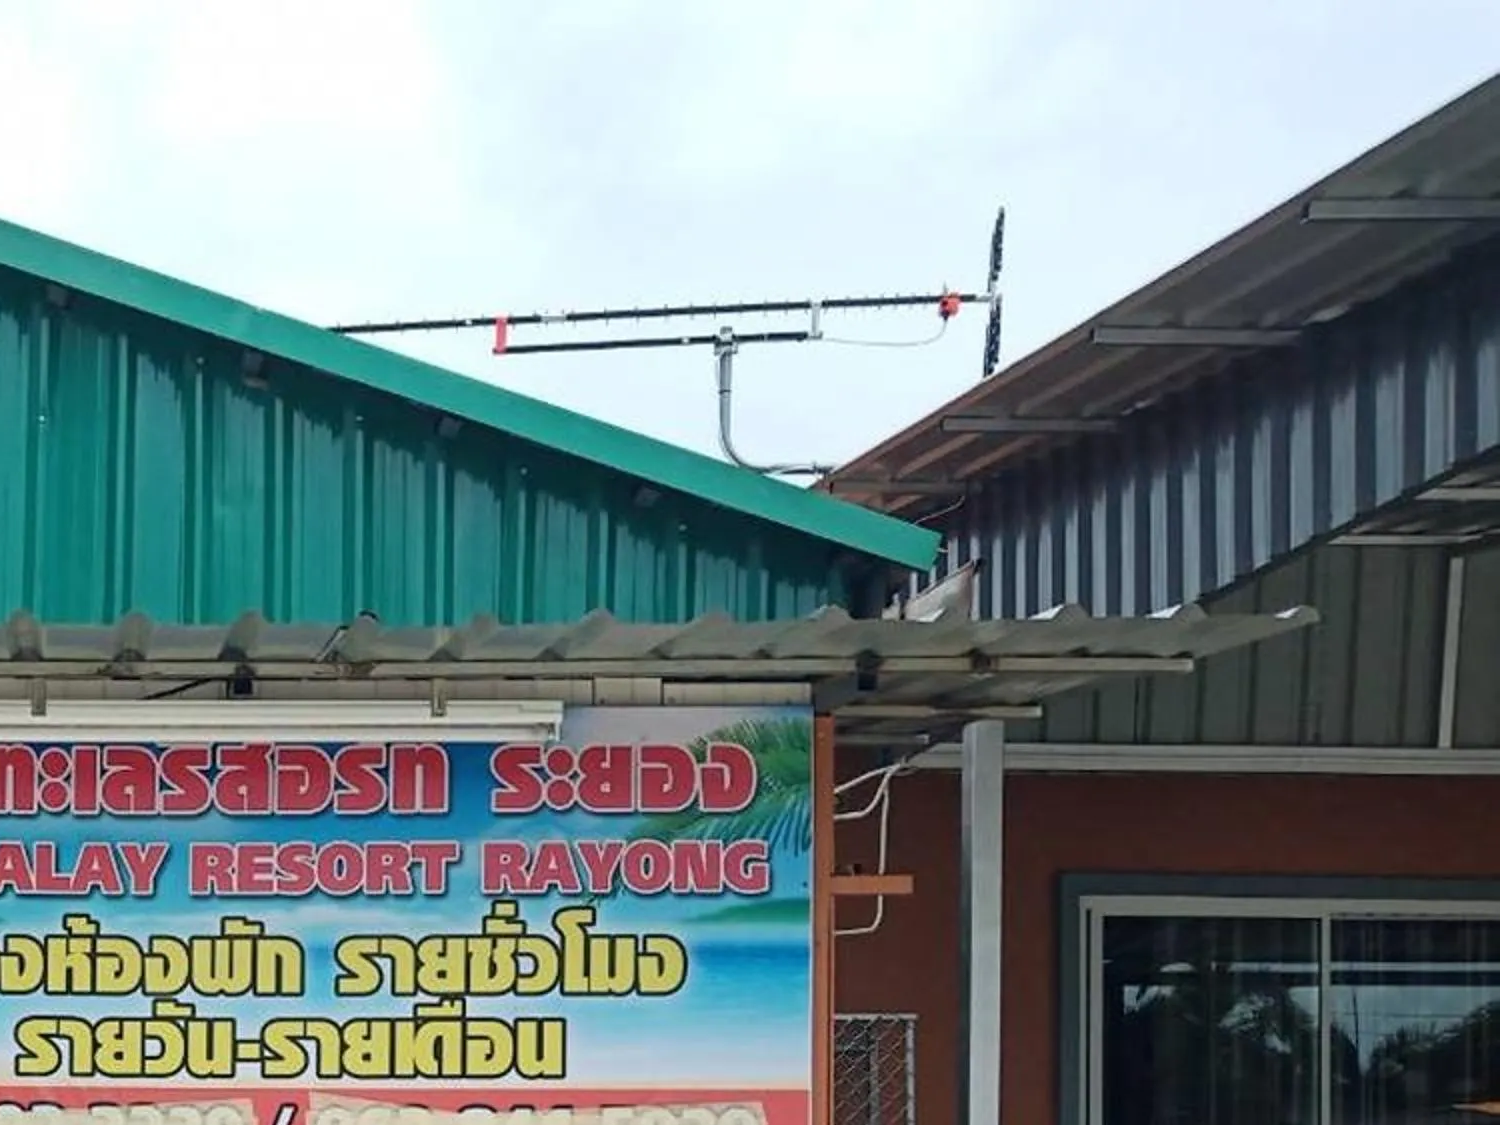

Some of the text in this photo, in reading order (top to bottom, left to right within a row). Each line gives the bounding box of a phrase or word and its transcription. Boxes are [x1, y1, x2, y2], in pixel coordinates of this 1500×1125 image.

[490, 742, 758, 814] ระยอง
[189, 840, 460, 896] RESORT
[481, 839, 769, 895] RAYONG
[334, 900, 689, 997] รายชั่วโมง
[13, 998, 567, 1079] รายวัน-รายเดือน
